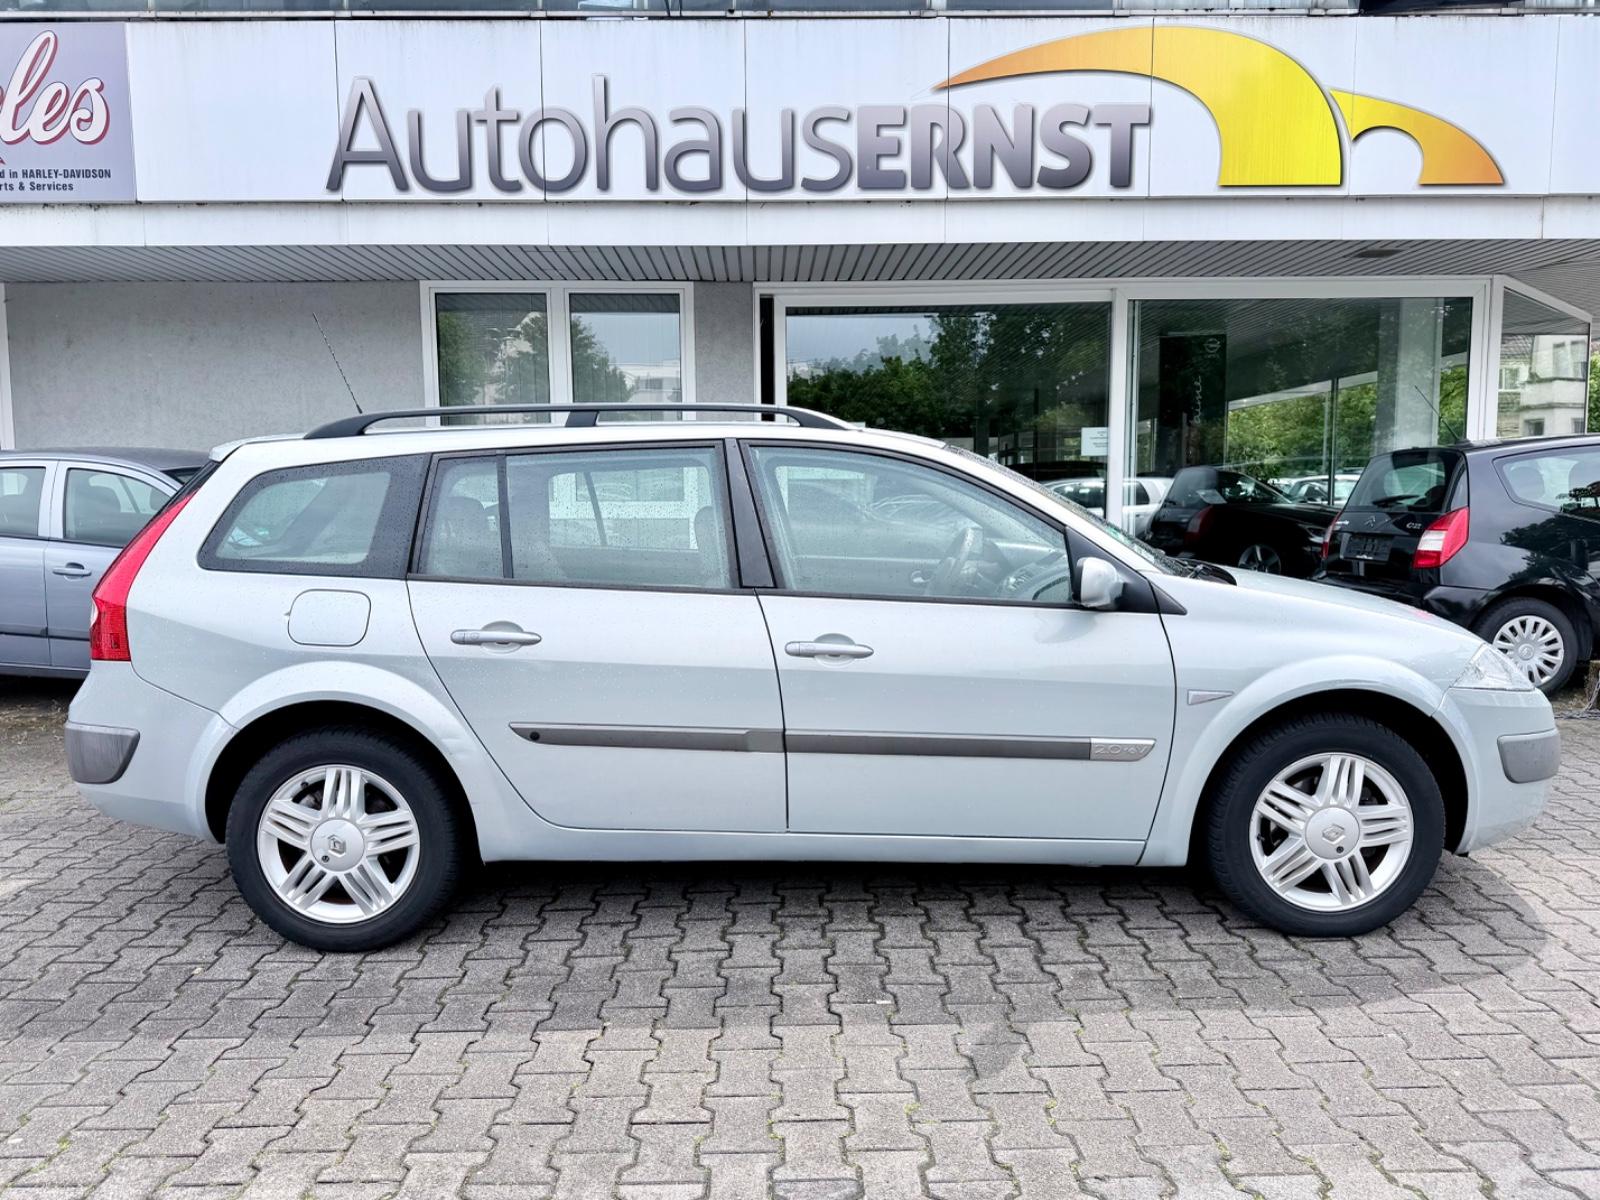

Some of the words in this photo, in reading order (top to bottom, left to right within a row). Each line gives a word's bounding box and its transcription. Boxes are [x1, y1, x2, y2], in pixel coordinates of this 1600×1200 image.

[0, 30, 110, 145] les
[9, 168, 18, 179] in
[21, 168, 112, 179] HARLEY-DAVIDSON
[18, 181, 25, 191] &
[29, 181, 74, 191] Services
